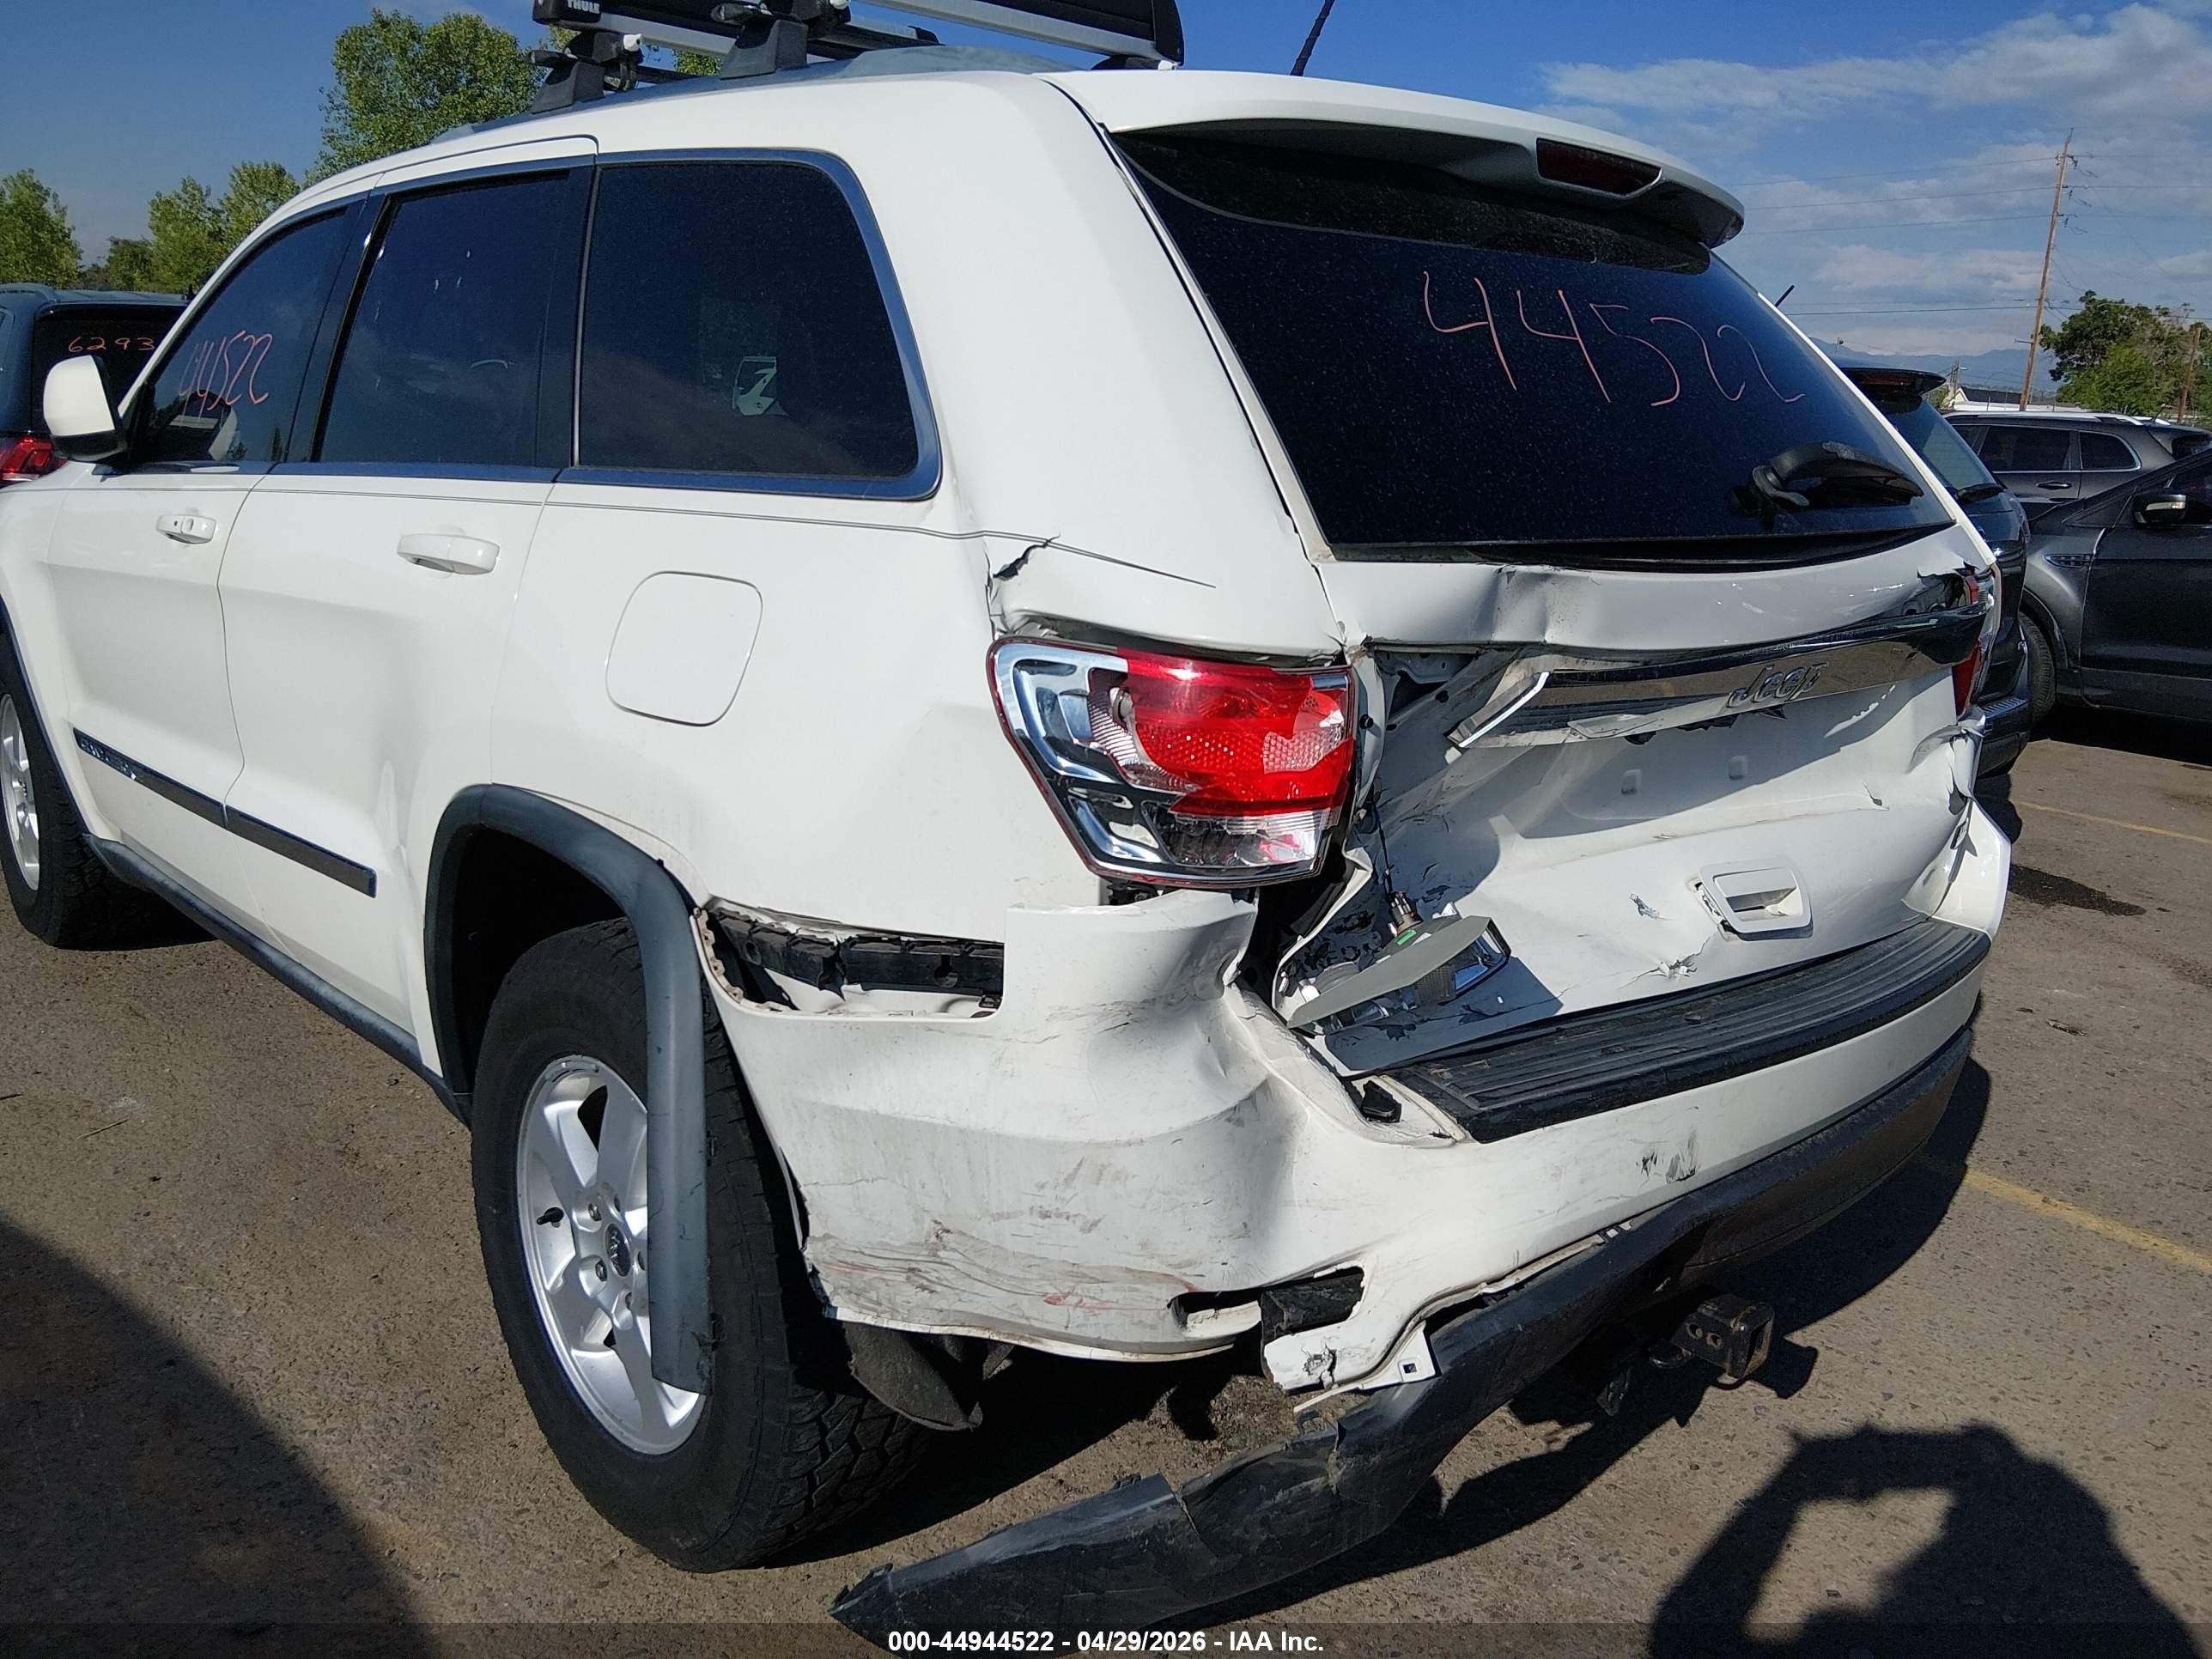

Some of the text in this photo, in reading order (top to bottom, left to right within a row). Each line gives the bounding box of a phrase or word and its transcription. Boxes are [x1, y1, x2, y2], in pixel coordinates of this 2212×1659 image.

[567, 0, 600, 15] THULE
[1422, 270, 1807, 407] 44522
[178, 329, 274, 421] 44522
[1726, 661, 1830, 708] Jeep
